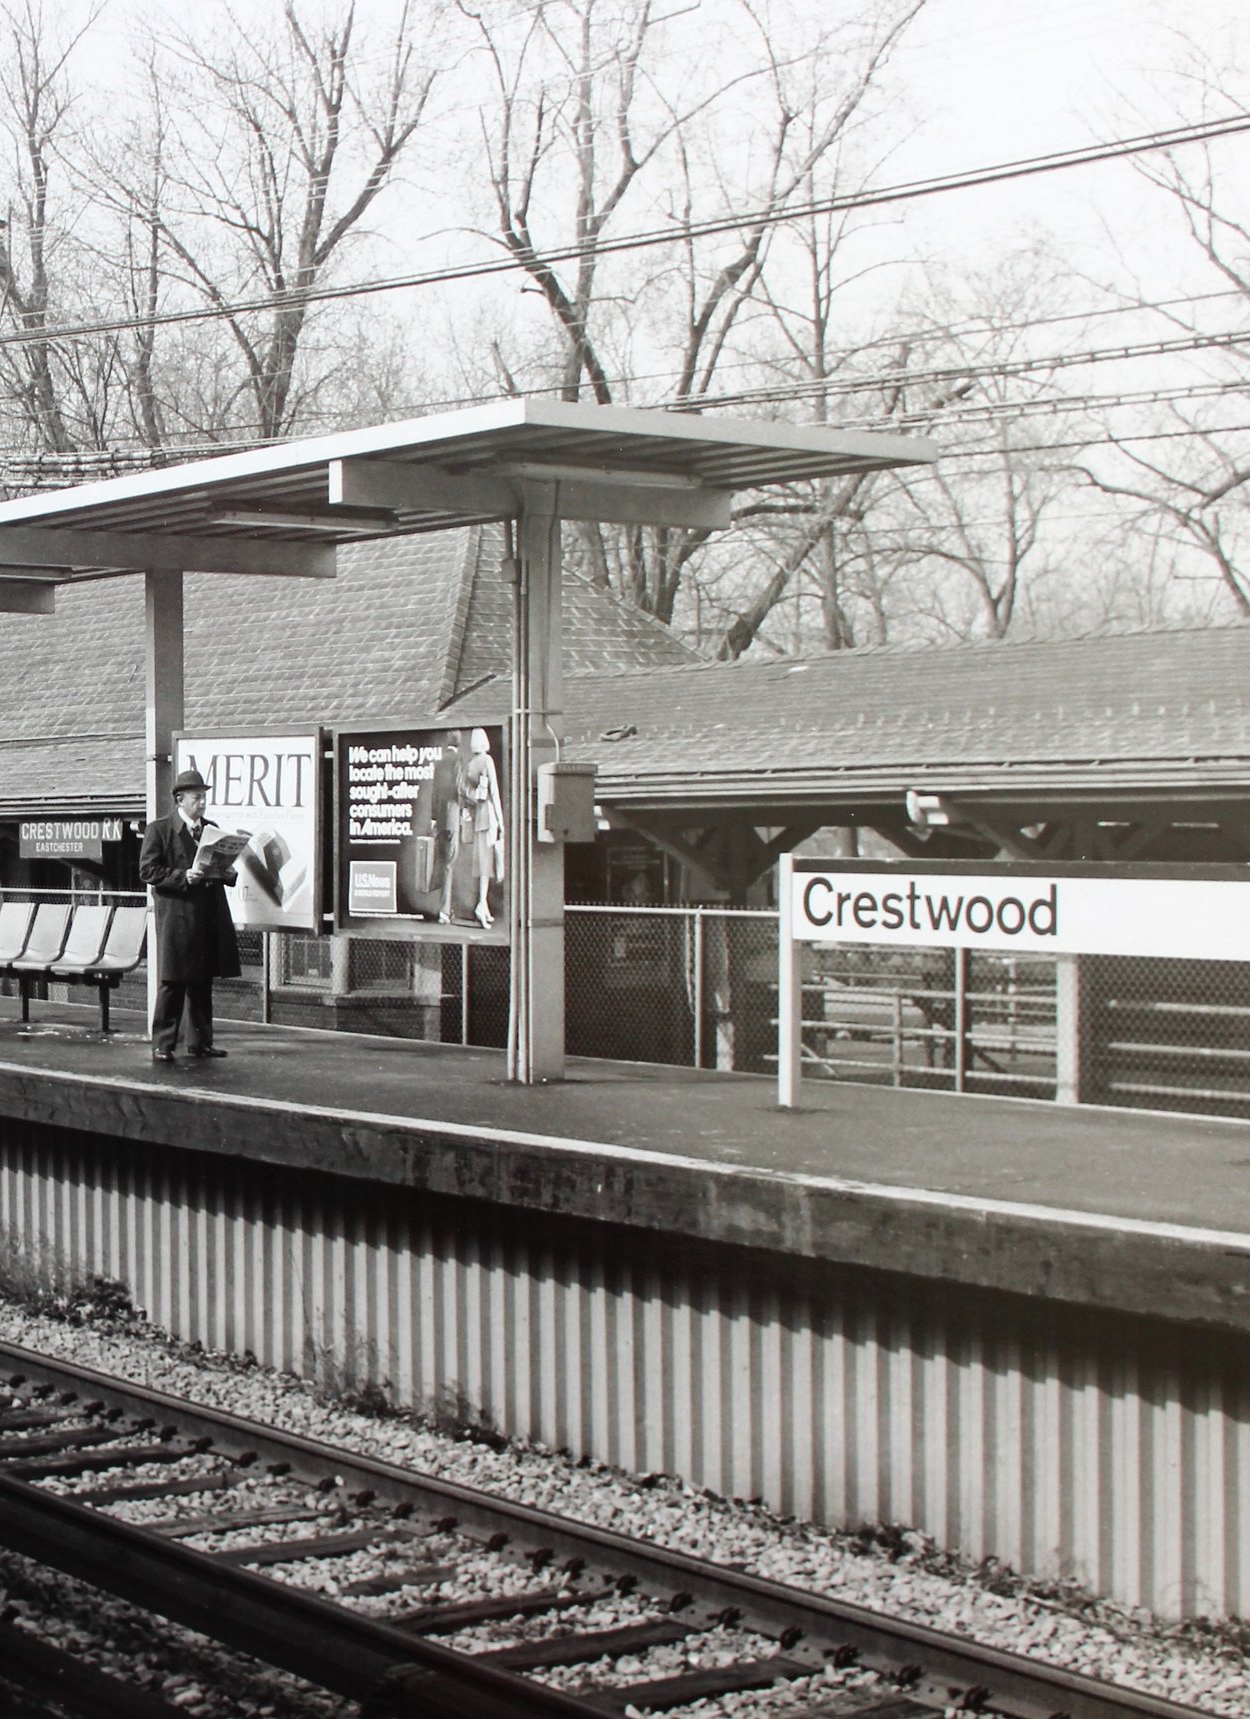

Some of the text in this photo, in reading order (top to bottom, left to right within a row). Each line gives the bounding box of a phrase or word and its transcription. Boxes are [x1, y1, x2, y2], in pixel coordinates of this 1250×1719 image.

[349, 744, 443, 765] We can help you
[186, 753, 312, 807] MERIT
[349, 762, 435, 782] locate the most
[349, 781, 419, 803] sought-after
[349, 803, 413, 818] consumers
[21, 821, 99, 840] CRESTWOOD
[349, 818, 413, 836] in America.
[35, 842, 83, 853] EASTCHESTER
[803, 876, 1058, 936] Crestwood
